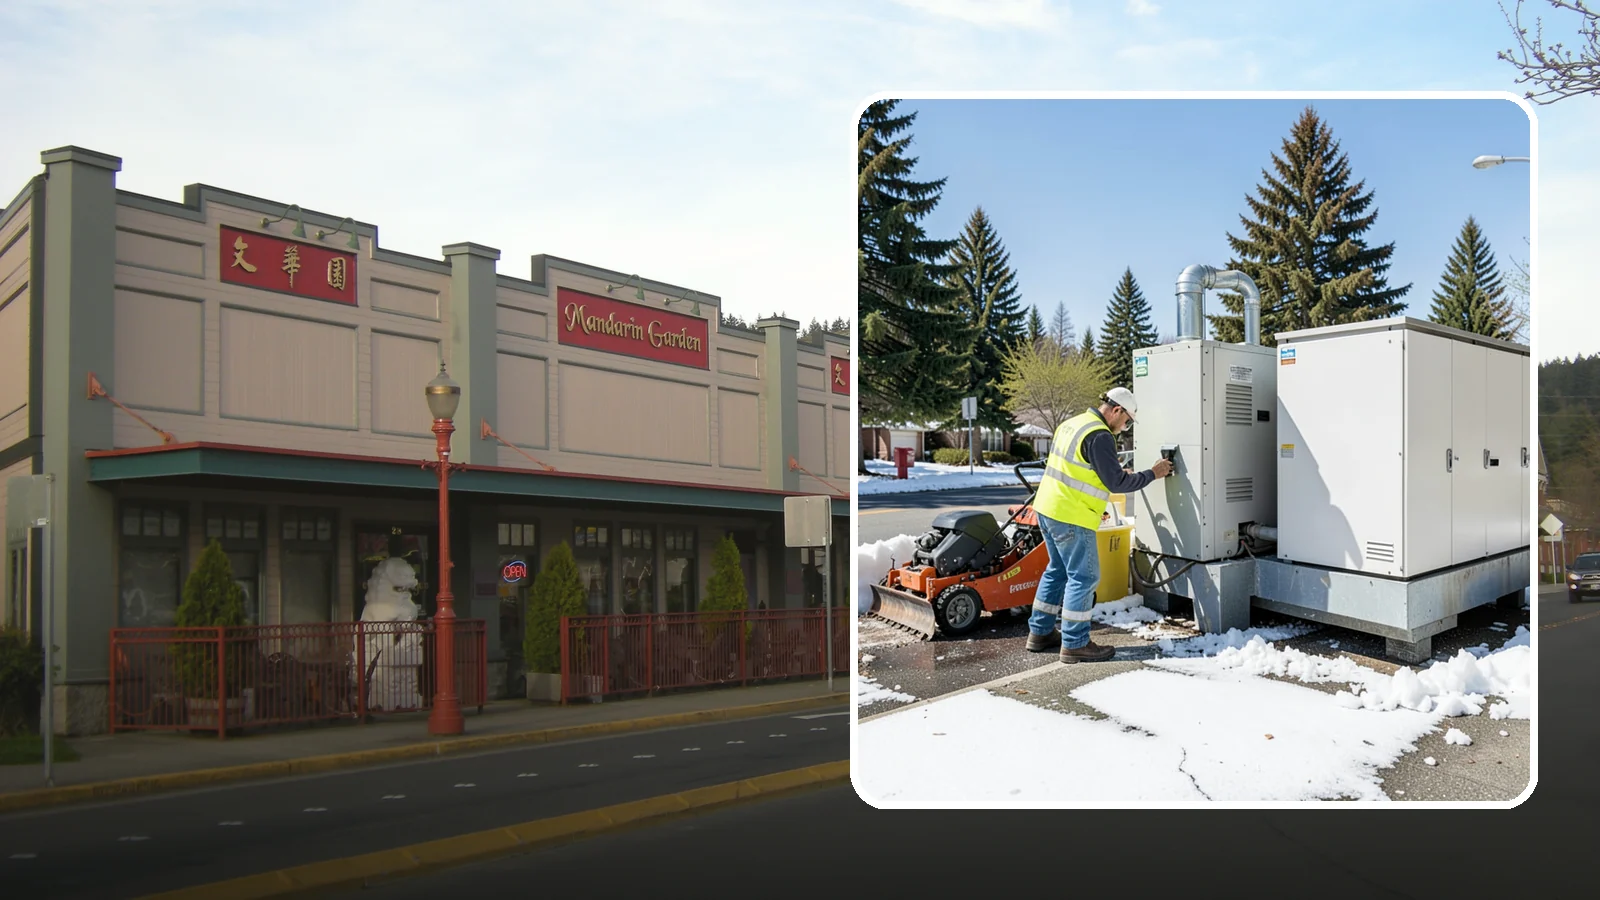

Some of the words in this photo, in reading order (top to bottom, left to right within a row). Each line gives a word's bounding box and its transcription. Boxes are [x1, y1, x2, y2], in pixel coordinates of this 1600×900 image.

[231, 235, 346, 291] 文華園
[564, 302, 644, 341] Mandarin
[648, 320, 701, 352] Garden
[503, 565, 527, 578] OPEN
